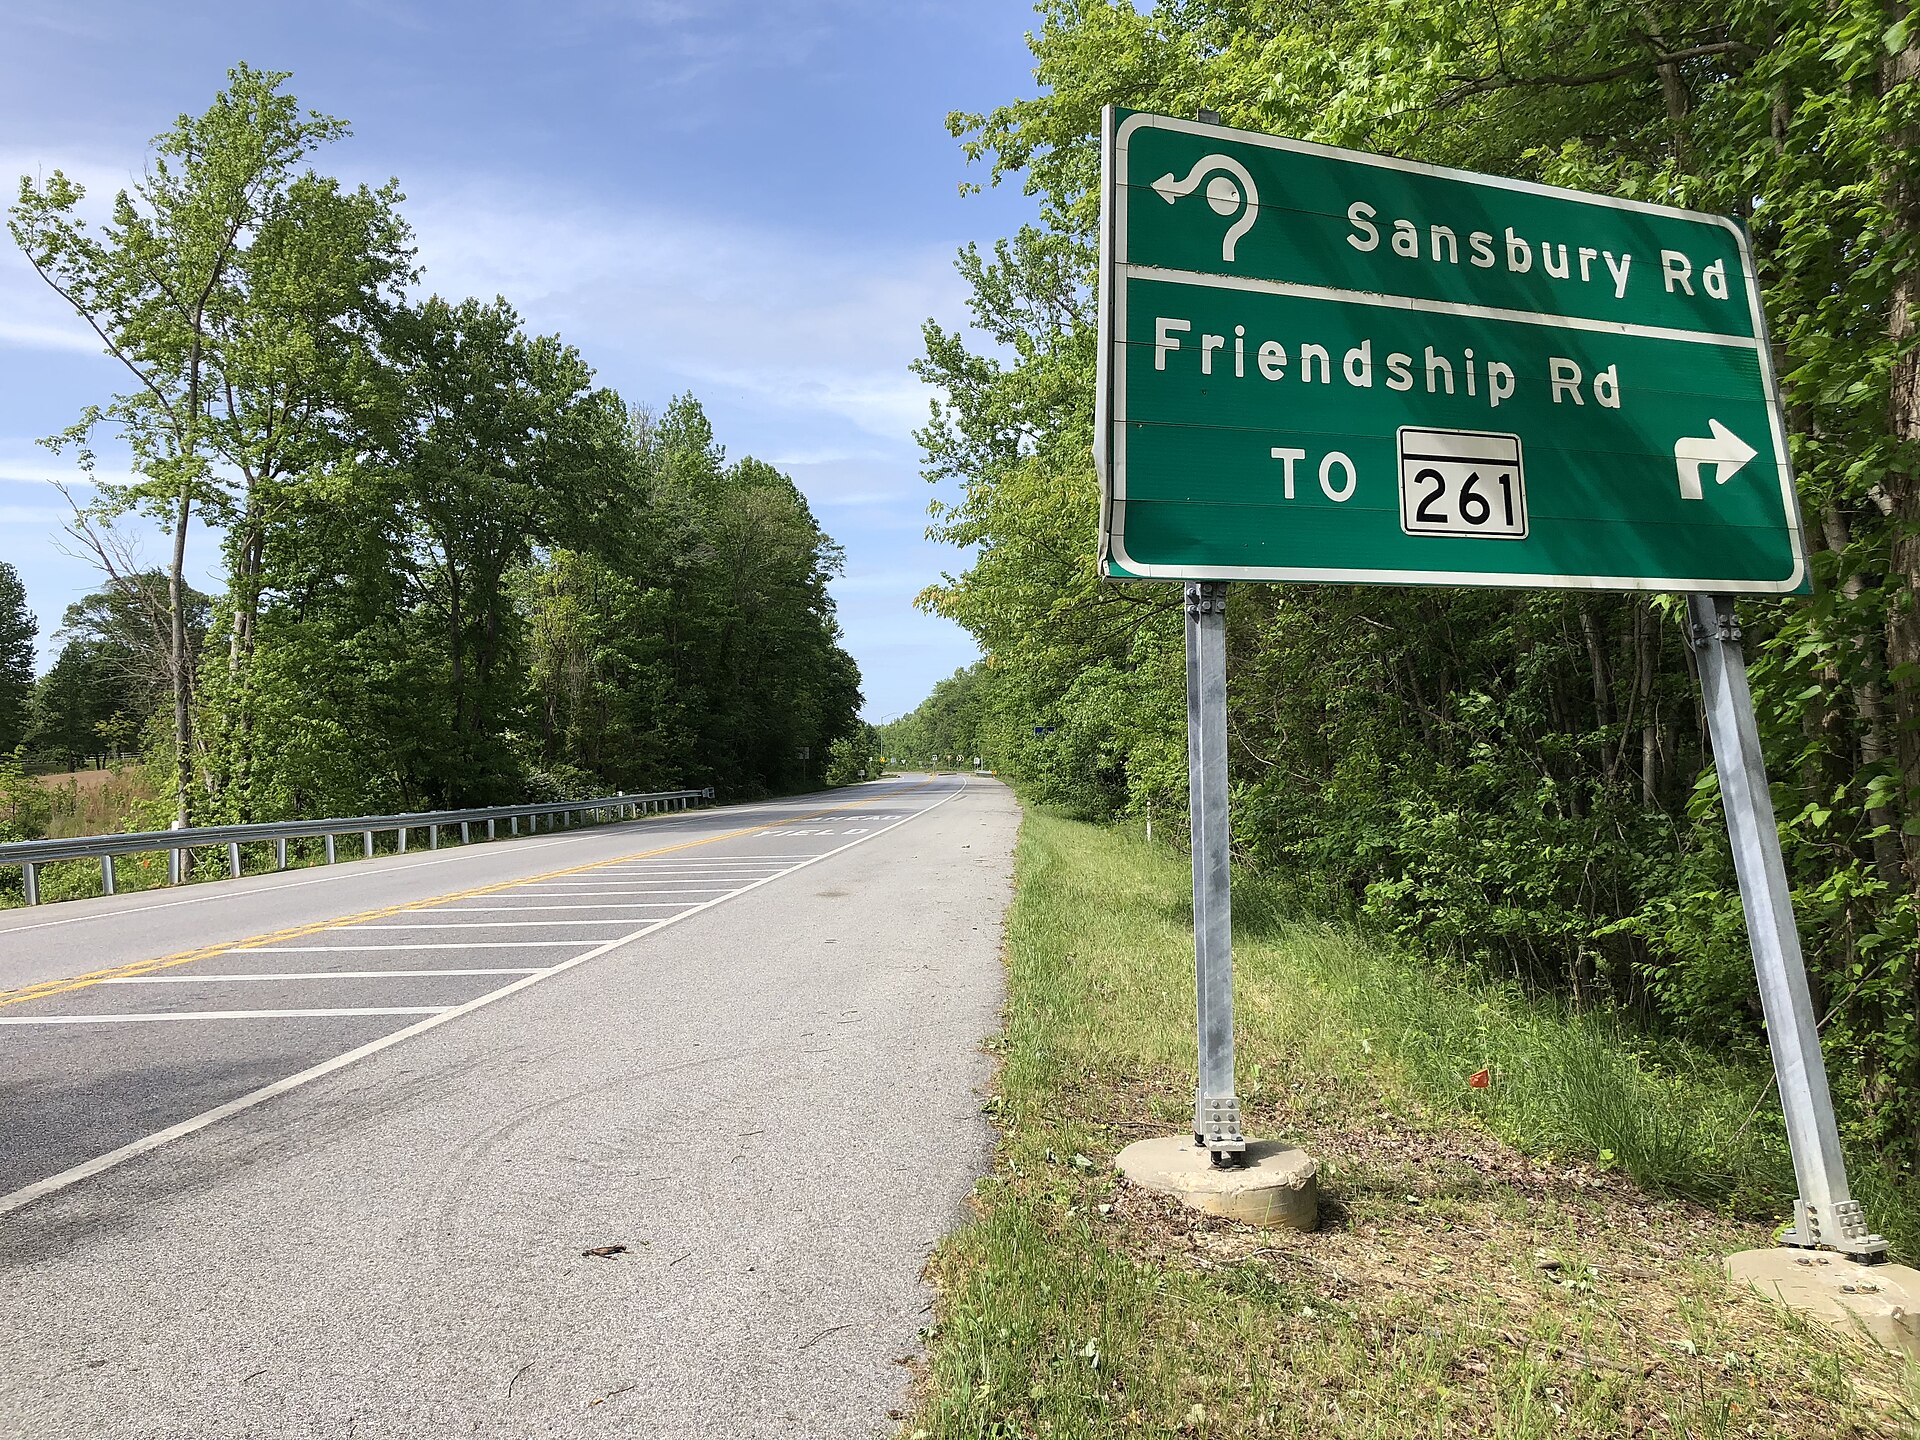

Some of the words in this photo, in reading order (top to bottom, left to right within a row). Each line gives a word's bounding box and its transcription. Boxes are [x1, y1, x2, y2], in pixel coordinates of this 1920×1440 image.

[1346, 201, 1632, 299] Sansbury
[1660, 249, 1729, 301] Rd
[1154, 317, 1515, 408] Friendship
[1549, 357, 1621, 409] Rd
[1270, 447, 1357, 503] TO
[1413, 468, 1516, 527] 261
[752, 828, 870, 837] YIELD
